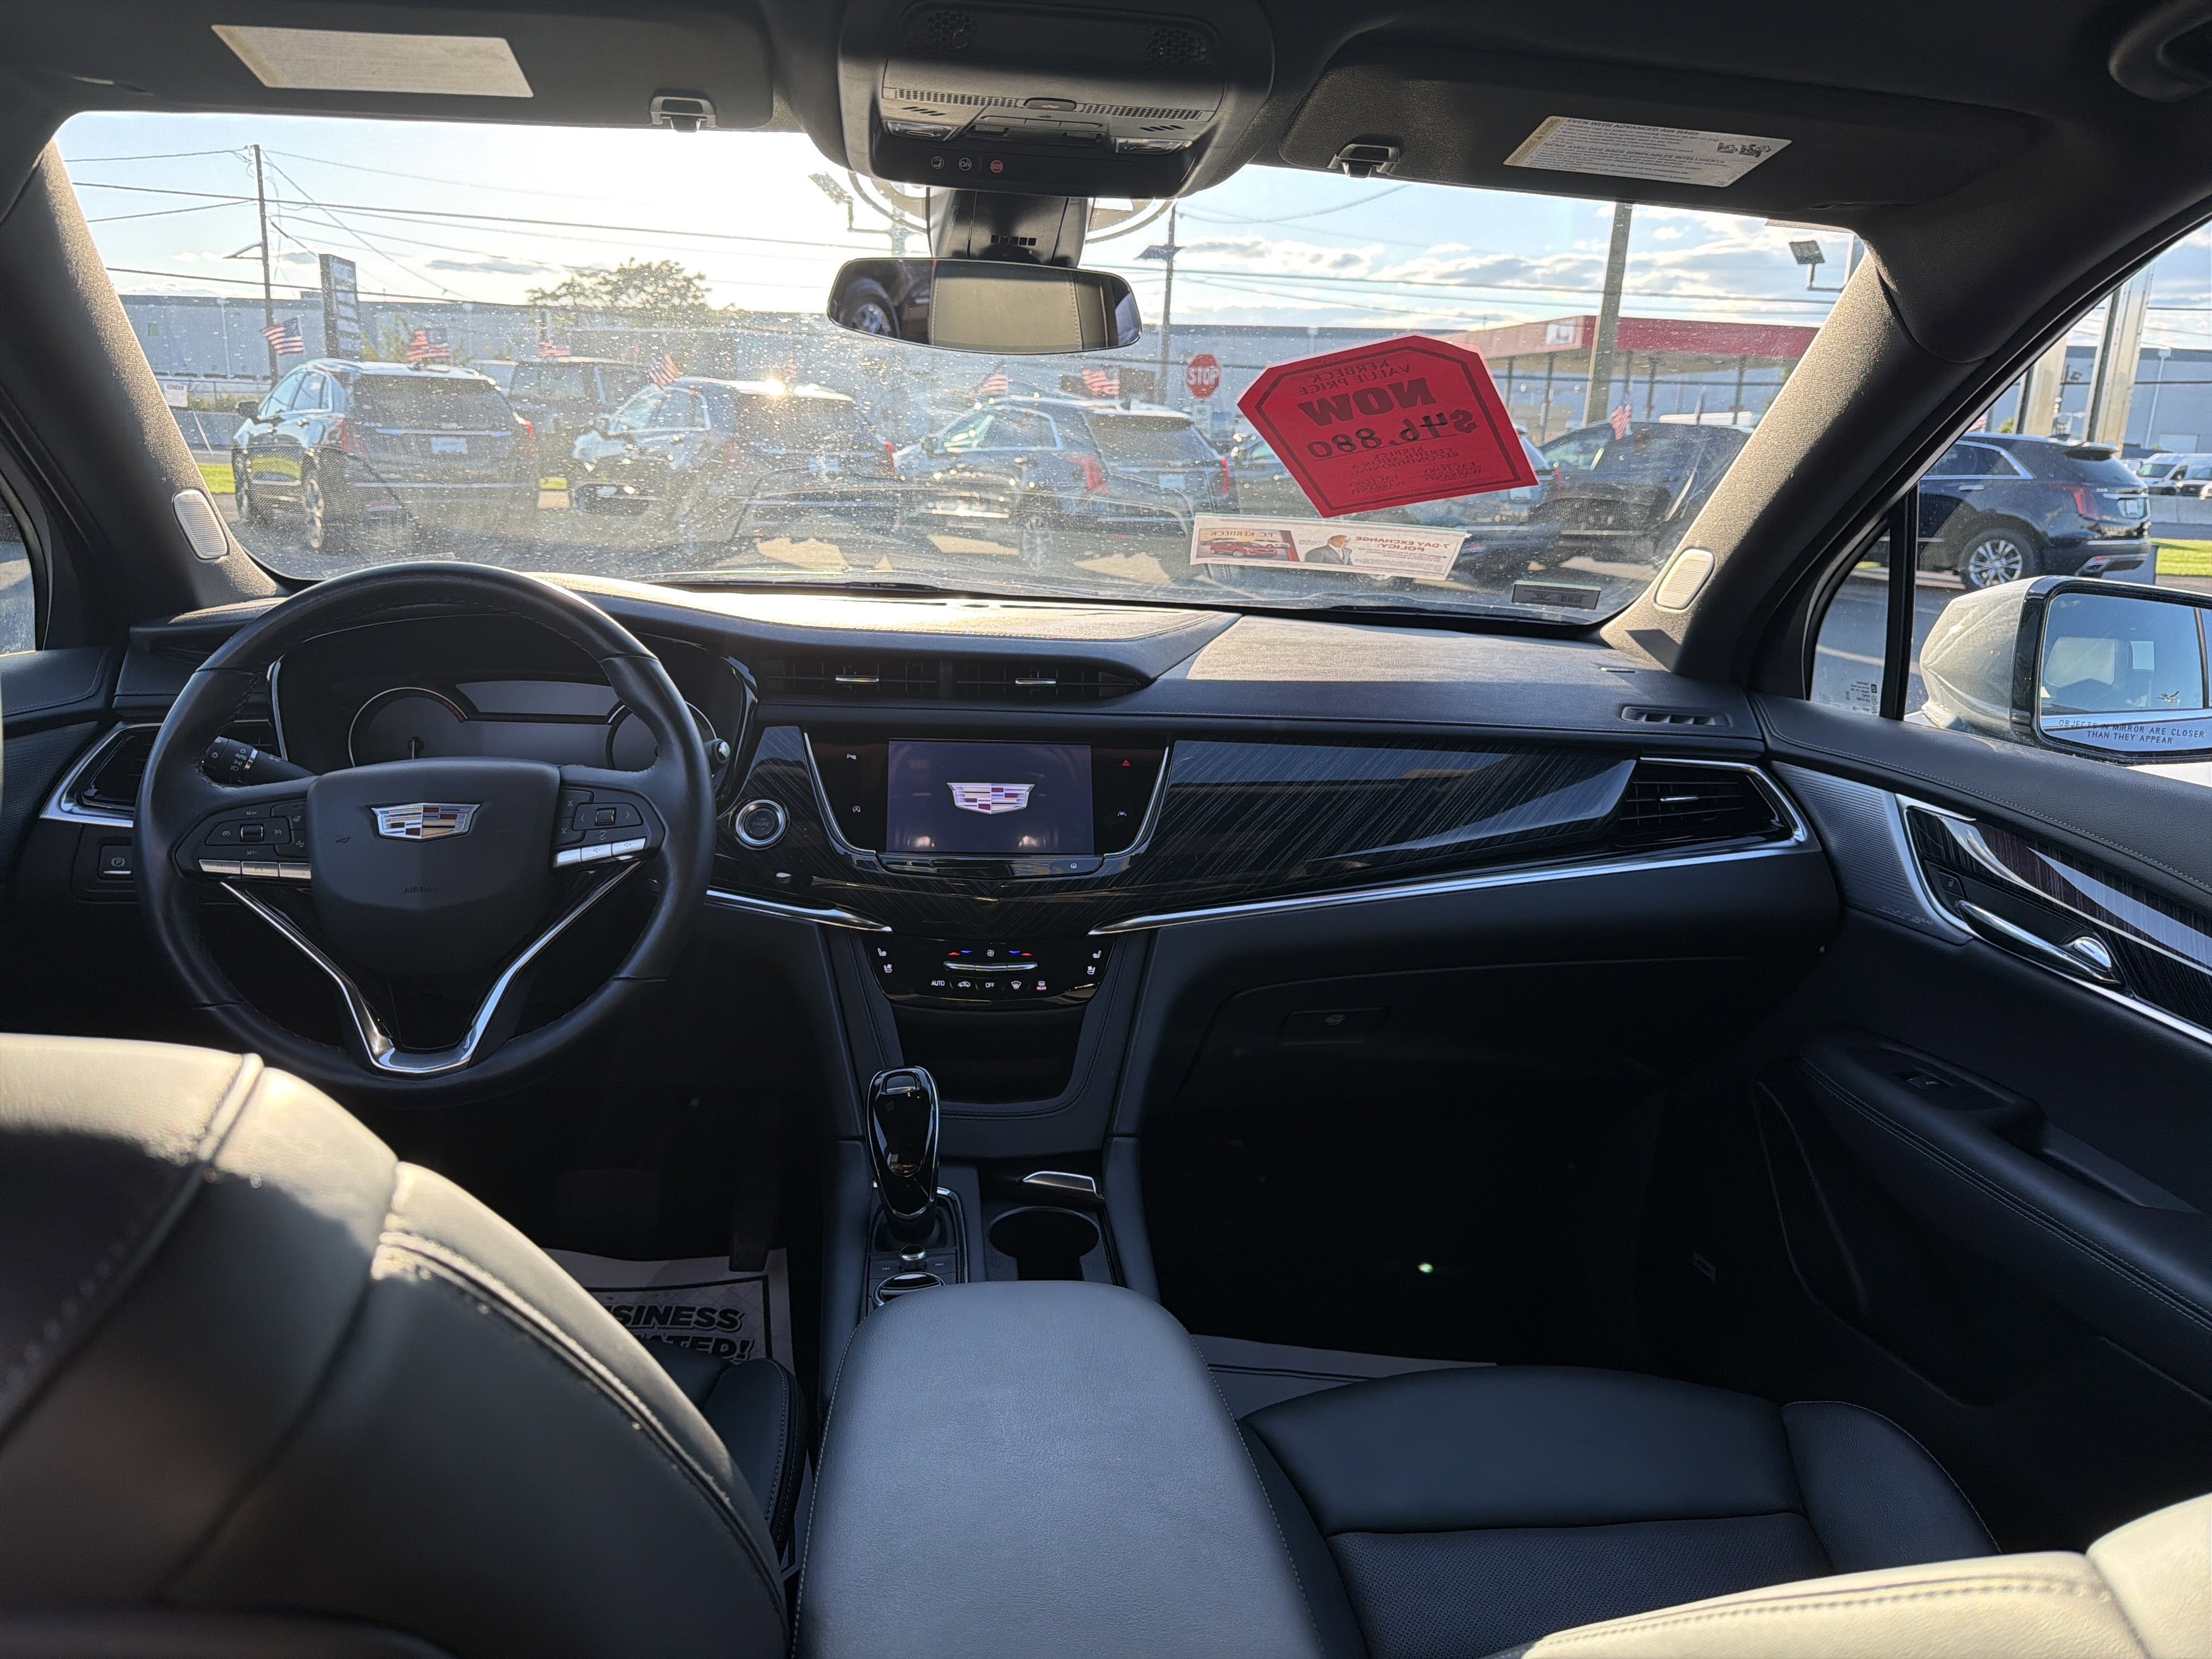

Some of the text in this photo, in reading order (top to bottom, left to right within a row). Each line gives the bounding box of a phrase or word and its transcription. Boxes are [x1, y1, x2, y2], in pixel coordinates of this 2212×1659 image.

[1187, 367, 1221, 385] STOP
[2058, 719, 2097, 729] OBJECTS
[2112, 724, 2145, 733] MIRROR
[2149, 727, 2166, 736] ARE
[2171, 729, 2205, 738] CLOSER
[2087, 730, 2173, 744] THAN THEY APPEAR
[235, 752, 247, 761] AUTO
[604, 1305, 743, 1332] SINESS
